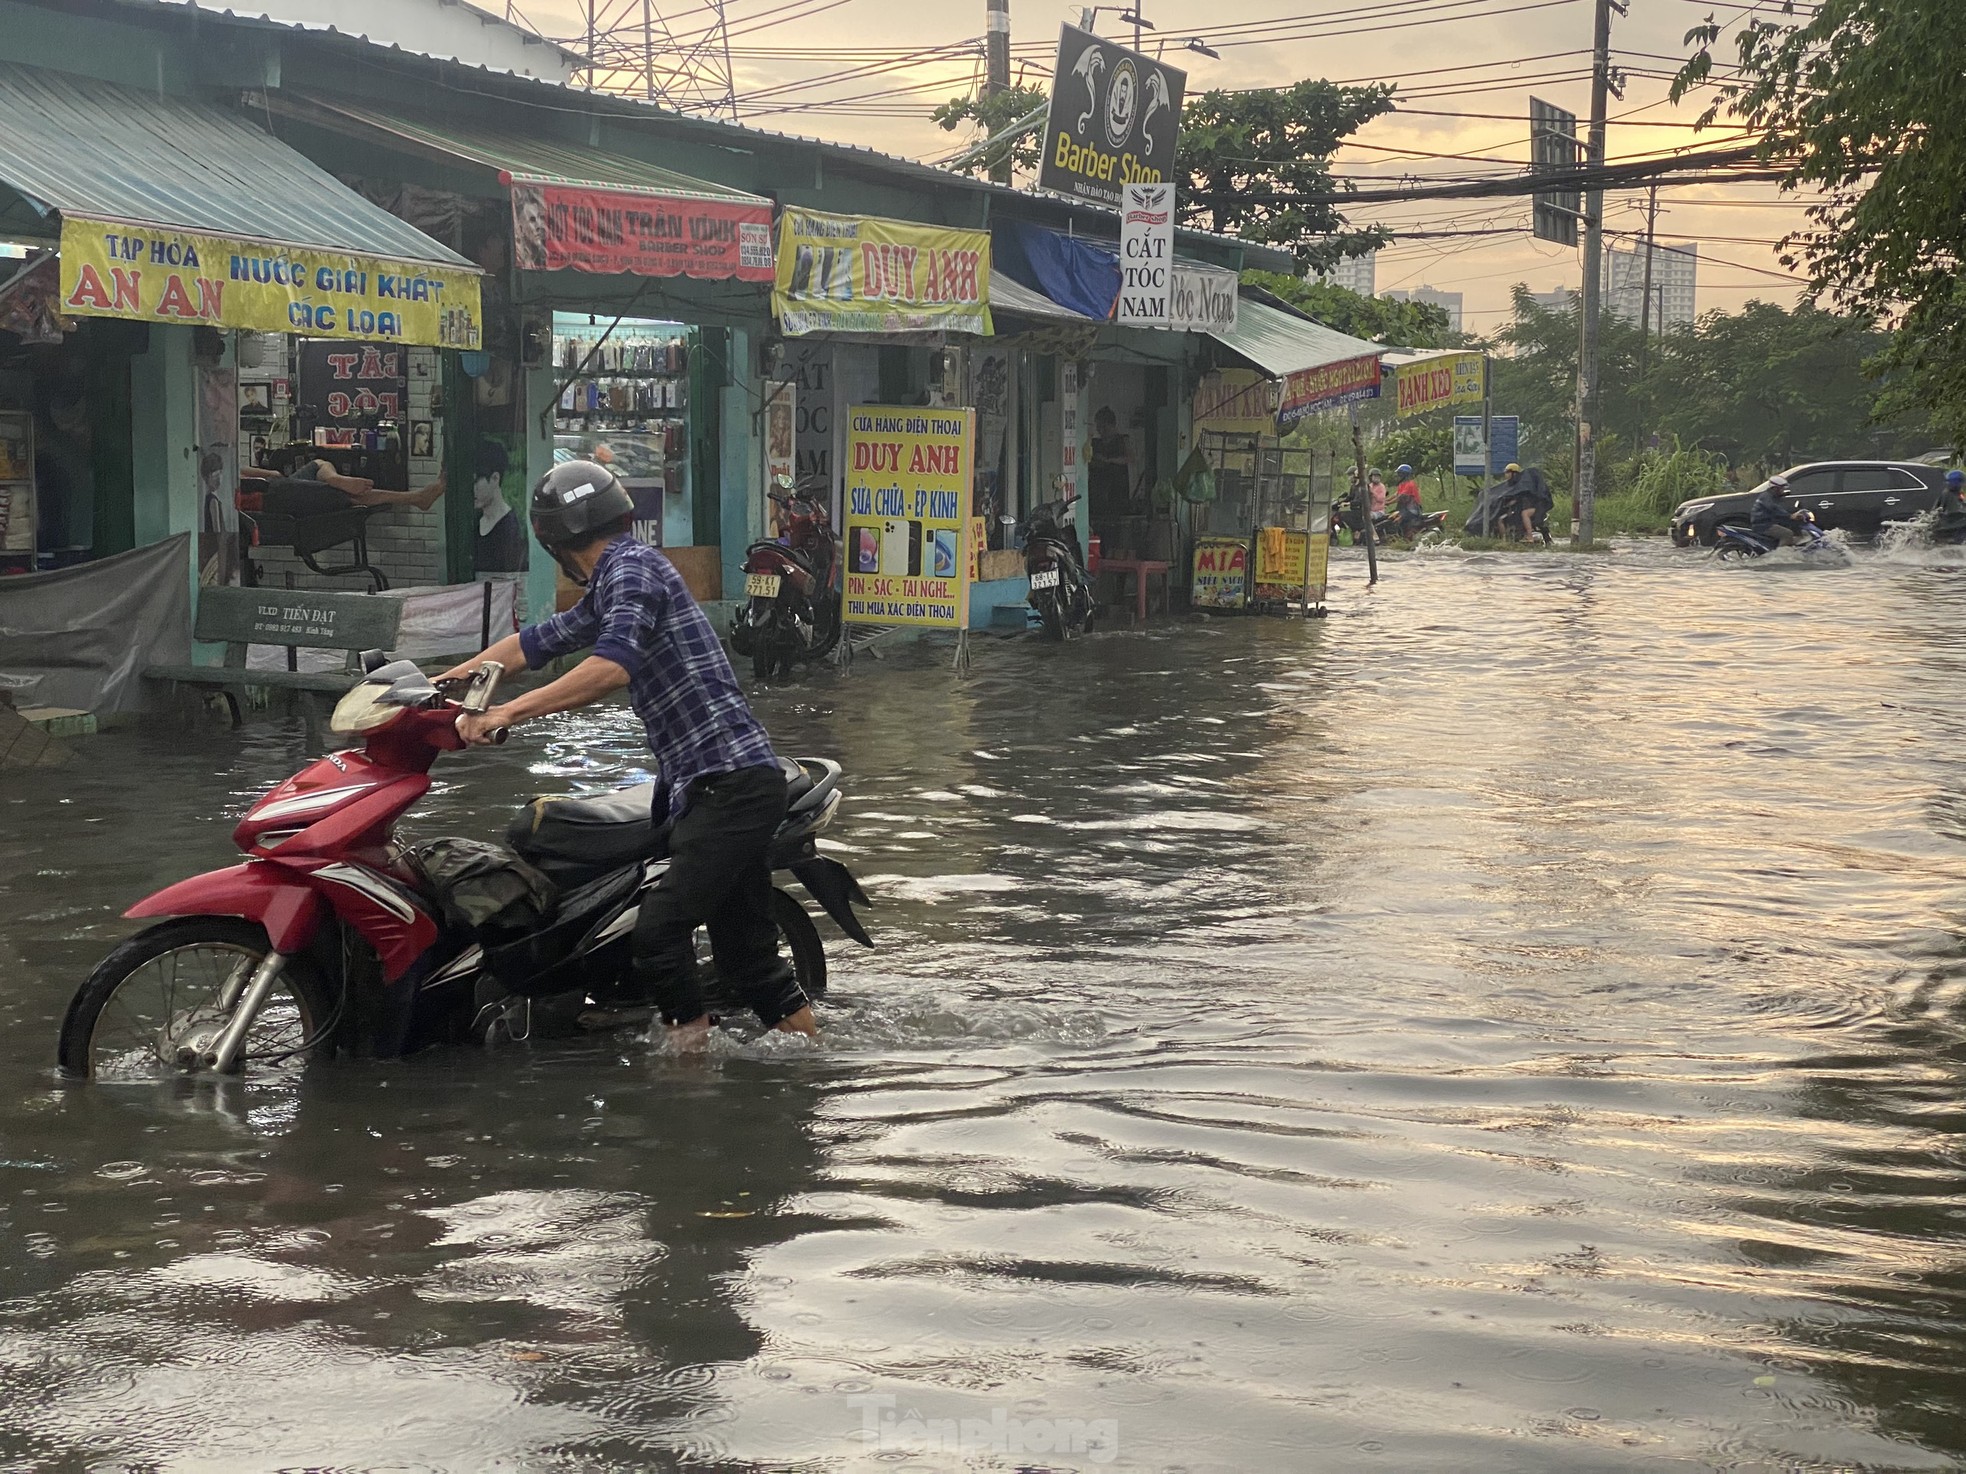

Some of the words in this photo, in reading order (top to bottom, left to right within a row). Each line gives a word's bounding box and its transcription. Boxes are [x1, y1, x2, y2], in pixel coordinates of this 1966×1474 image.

[1055, 131, 1118, 182] Barber
[105, 233, 145, 265] TẠP
[1126, 227, 1166, 258] CẮT
[230, 253, 306, 288] NƯỚC
[377, 271, 444, 304] KHÁT
[861, 241, 918, 304] DUY
[923, 247, 980, 304] ANH
[1125, 261, 1165, 288] TÓC
[66, 263, 142, 314] AN
[154, 273, 226, 321] AN
[1122, 297, 1166, 318] NAM
[1198, 276, 1235, 323] Nam
[288, 296, 336, 331] CÁC
[347, 307, 402, 341] LOẠI
[1398, 367, 1429, 409] BÁNH
[796, 396, 828, 434] ÓC
[852, 412, 873, 432] CỬA
[875, 414, 904, 433] HÀNG
[906, 415, 929, 437] ĐIỆN
[931, 418, 962, 438] THOẠI
[796, 448, 828, 477] AM
[853, 441, 904, 473] DUY
[907, 443, 960, 475] ANH
[850, 478, 872, 515] SỬA
[875, 482, 905, 517] CHỮA
[914, 483, 927, 518] ÉP
[929, 484, 958, 519] KÍNH
[747, 584, 776, 596] 271.51
[848, 577, 865, 595] PIN
[873, 578, 894, 600] SẠC
[902, 579, 917, 597] TAI
[282, 603, 311, 621] TIẾN
[311, 609, 336, 625] ĐẠT
[848, 600, 865, 615] THU
[867, 601, 885, 616] MUA
[887, 600, 905, 616] XÁC
[906, 601, 926, 619] ĐIỆN
[928, 603, 955, 621] THOẠI
[322, 754, 347, 771] NDA
